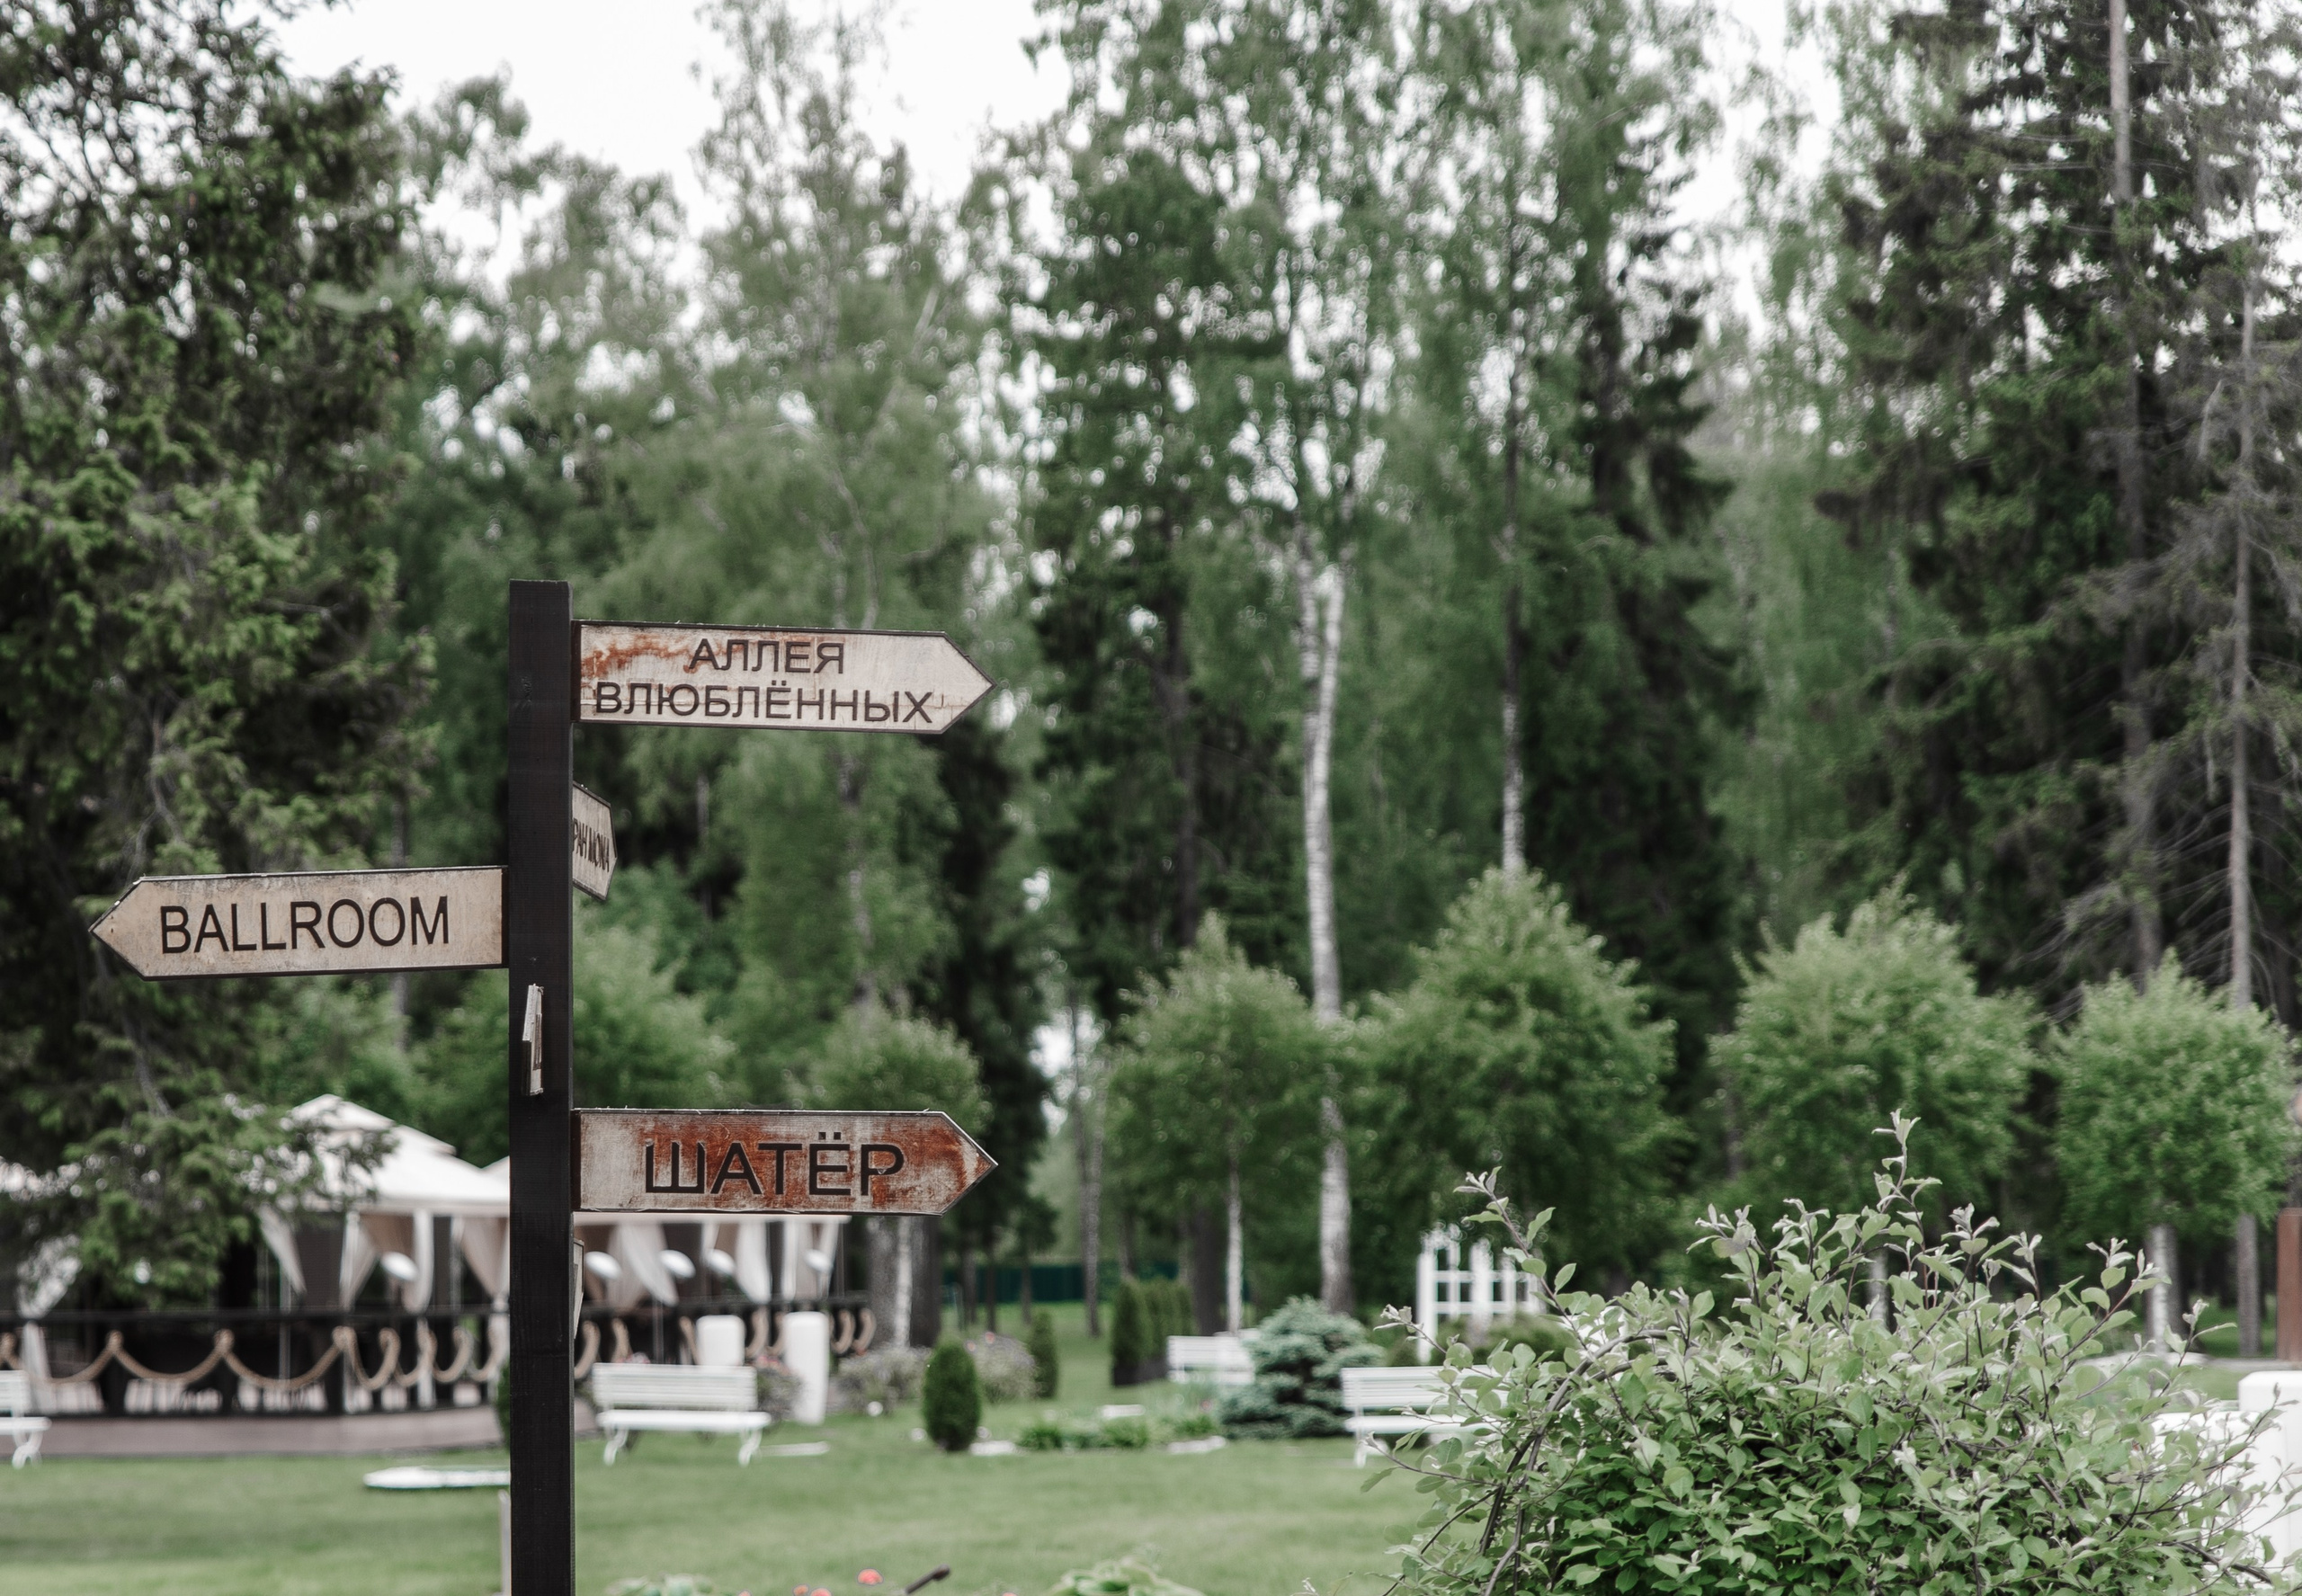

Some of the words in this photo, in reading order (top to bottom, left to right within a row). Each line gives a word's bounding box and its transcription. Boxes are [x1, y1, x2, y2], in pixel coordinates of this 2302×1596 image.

[688, 638, 845, 674] АЛЛЕЯ
[594, 679, 933, 724] ВЛЮБЛЁННЫХ
[159, 895, 450, 955] BALLROOM
[645, 1130, 905, 1197] ШАТЁР
